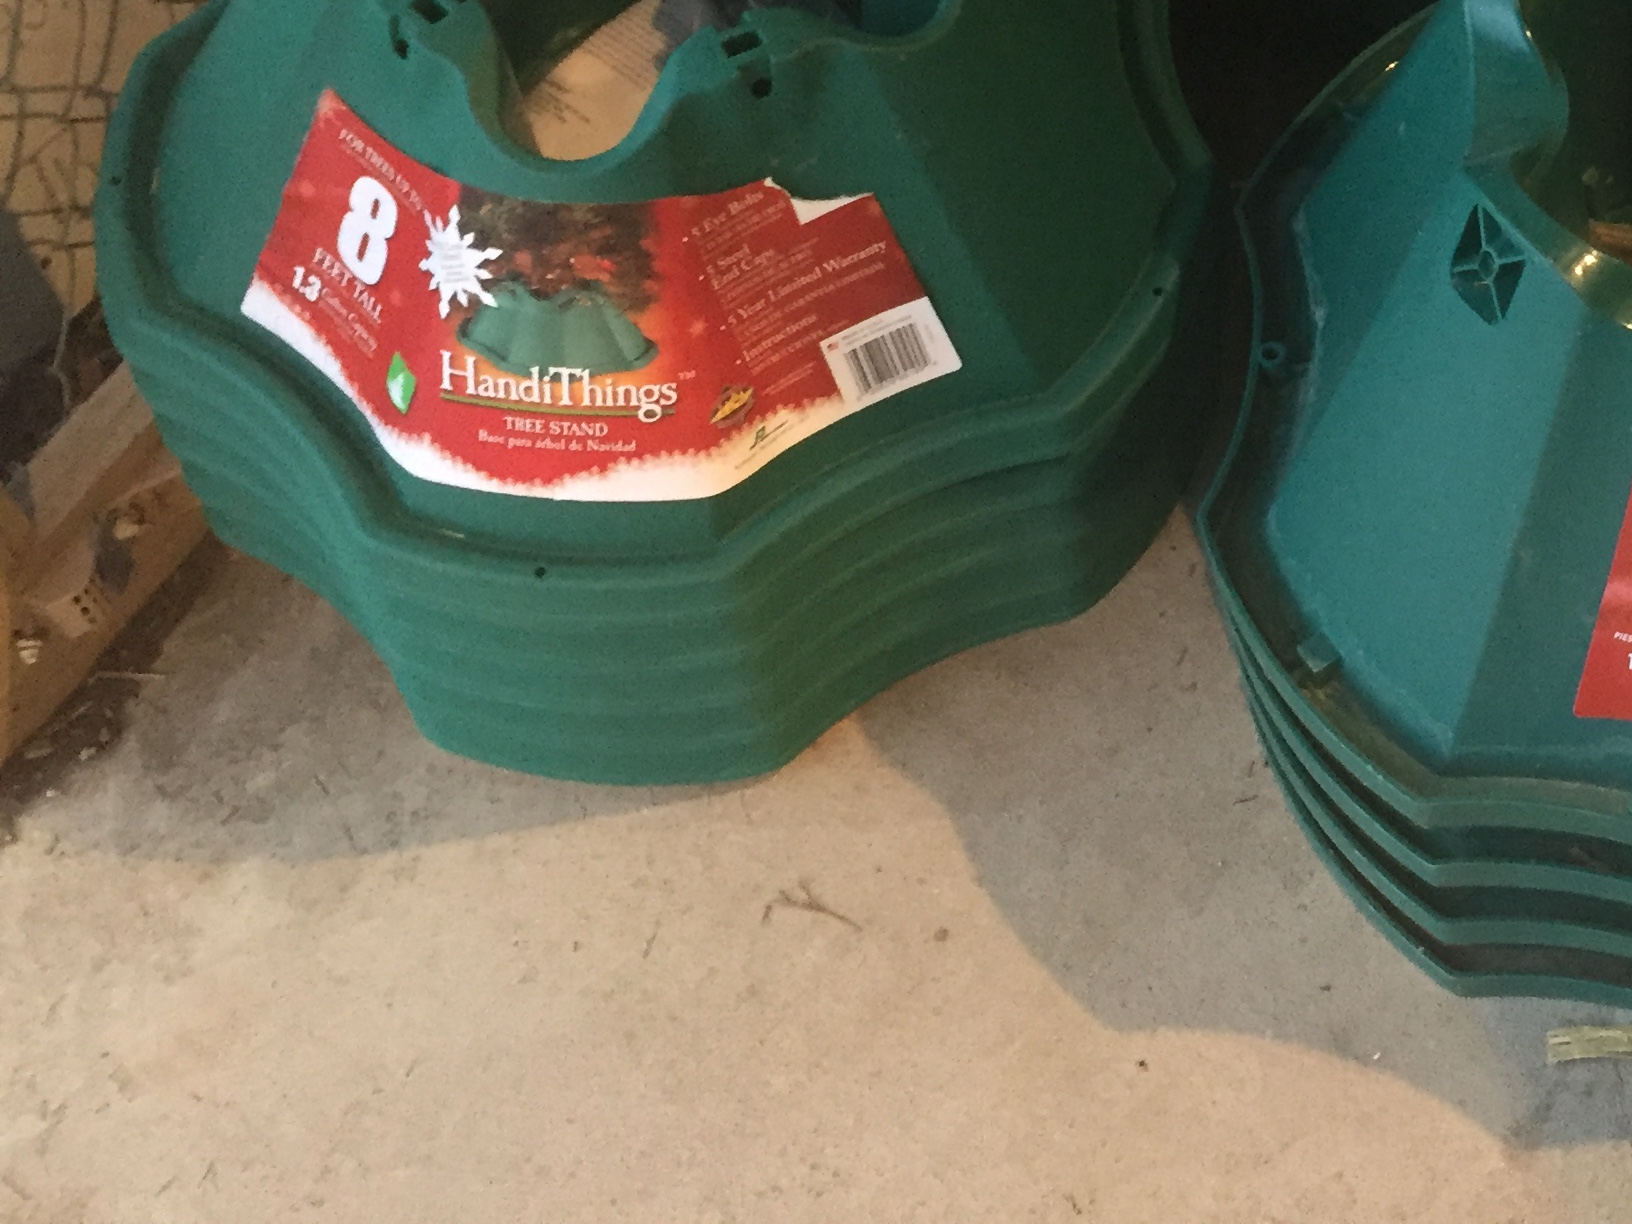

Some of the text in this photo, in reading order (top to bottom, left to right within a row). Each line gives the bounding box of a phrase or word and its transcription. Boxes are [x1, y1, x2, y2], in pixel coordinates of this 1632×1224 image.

[337, 176, 398, 285] 8
[313, 248, 352, 287] FEET
[353, 280, 382, 324] TALL
[440, 349, 678, 423] HandiThings
[503, 416, 608, 437] TREE STAND
[507, 437, 532, 449] para
[569, 439, 583, 451] de
[587, 439, 636, 452] Navidad
[1614, 631, 1632, 644] PIES
